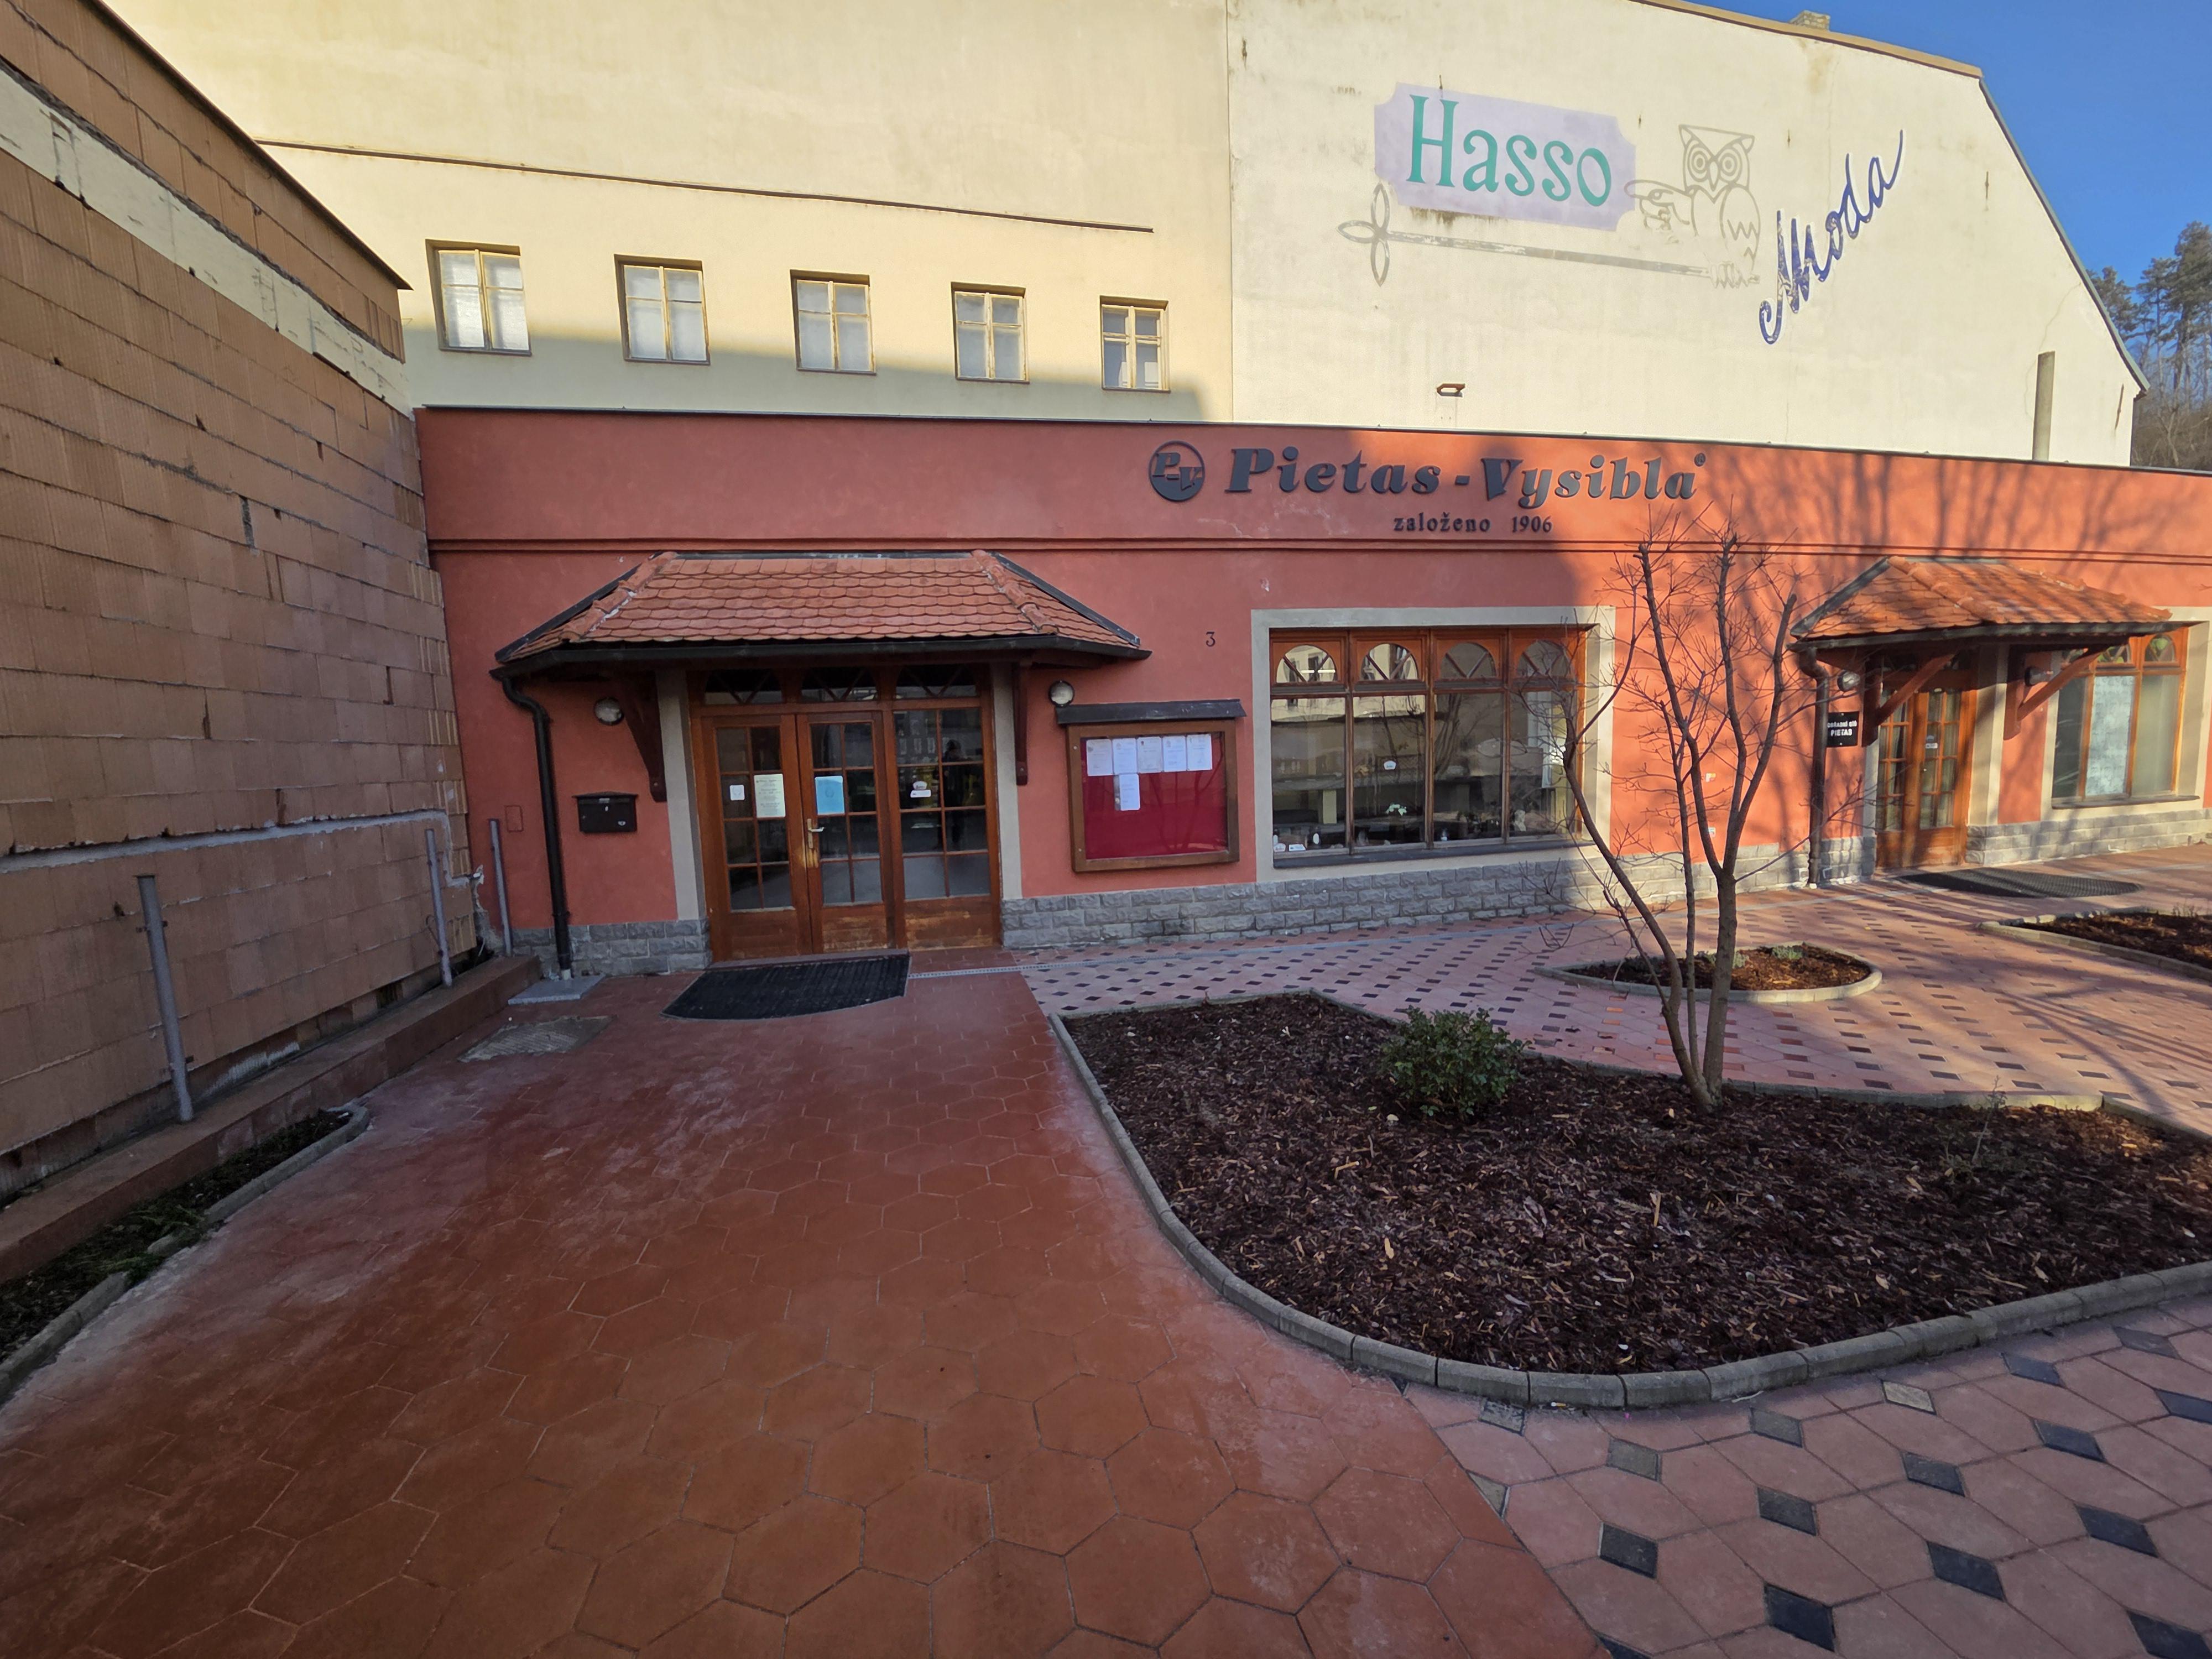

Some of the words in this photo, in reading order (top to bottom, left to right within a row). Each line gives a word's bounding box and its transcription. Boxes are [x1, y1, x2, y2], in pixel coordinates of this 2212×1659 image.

[1406, 93, 1612, 207] Hasso
[1759, 129, 1904, 345] Moda
[1224, 446, 1441, 494] Pietas
[1393, 512, 1491, 532] založeno
[1511, 515, 1553, 533] 1906
[1206, 631, 1215, 647] 3
[1830, 728, 1852, 737] PIETAS
